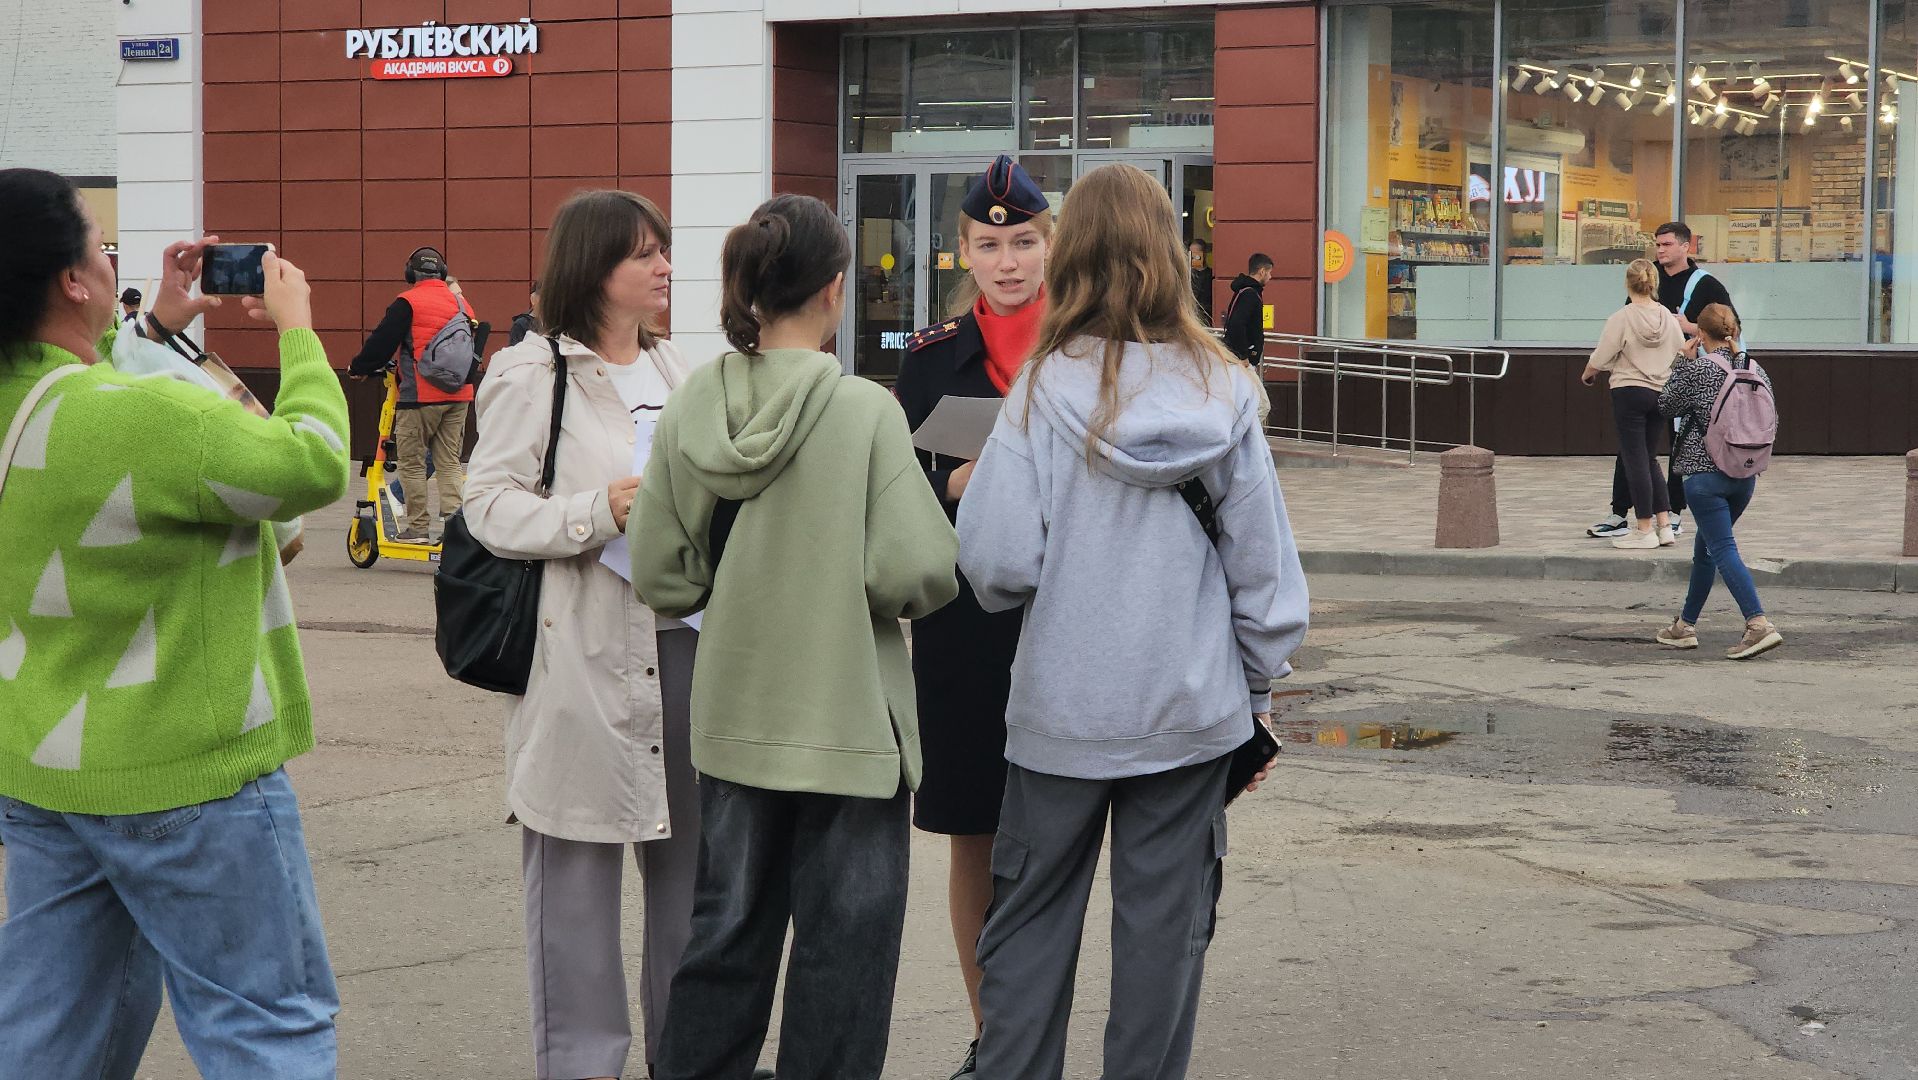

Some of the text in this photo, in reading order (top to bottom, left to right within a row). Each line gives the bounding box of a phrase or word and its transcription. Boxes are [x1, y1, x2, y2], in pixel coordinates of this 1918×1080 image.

[346, 17, 537, 58] РУБЛЁВСКИЙ
[123, 47, 156, 57] Ленина
[383, 62, 447, 77] АКАДЕМИЯ
[448, 60, 487, 74] ВКУСА
[886, 331, 904, 349] PRICE
